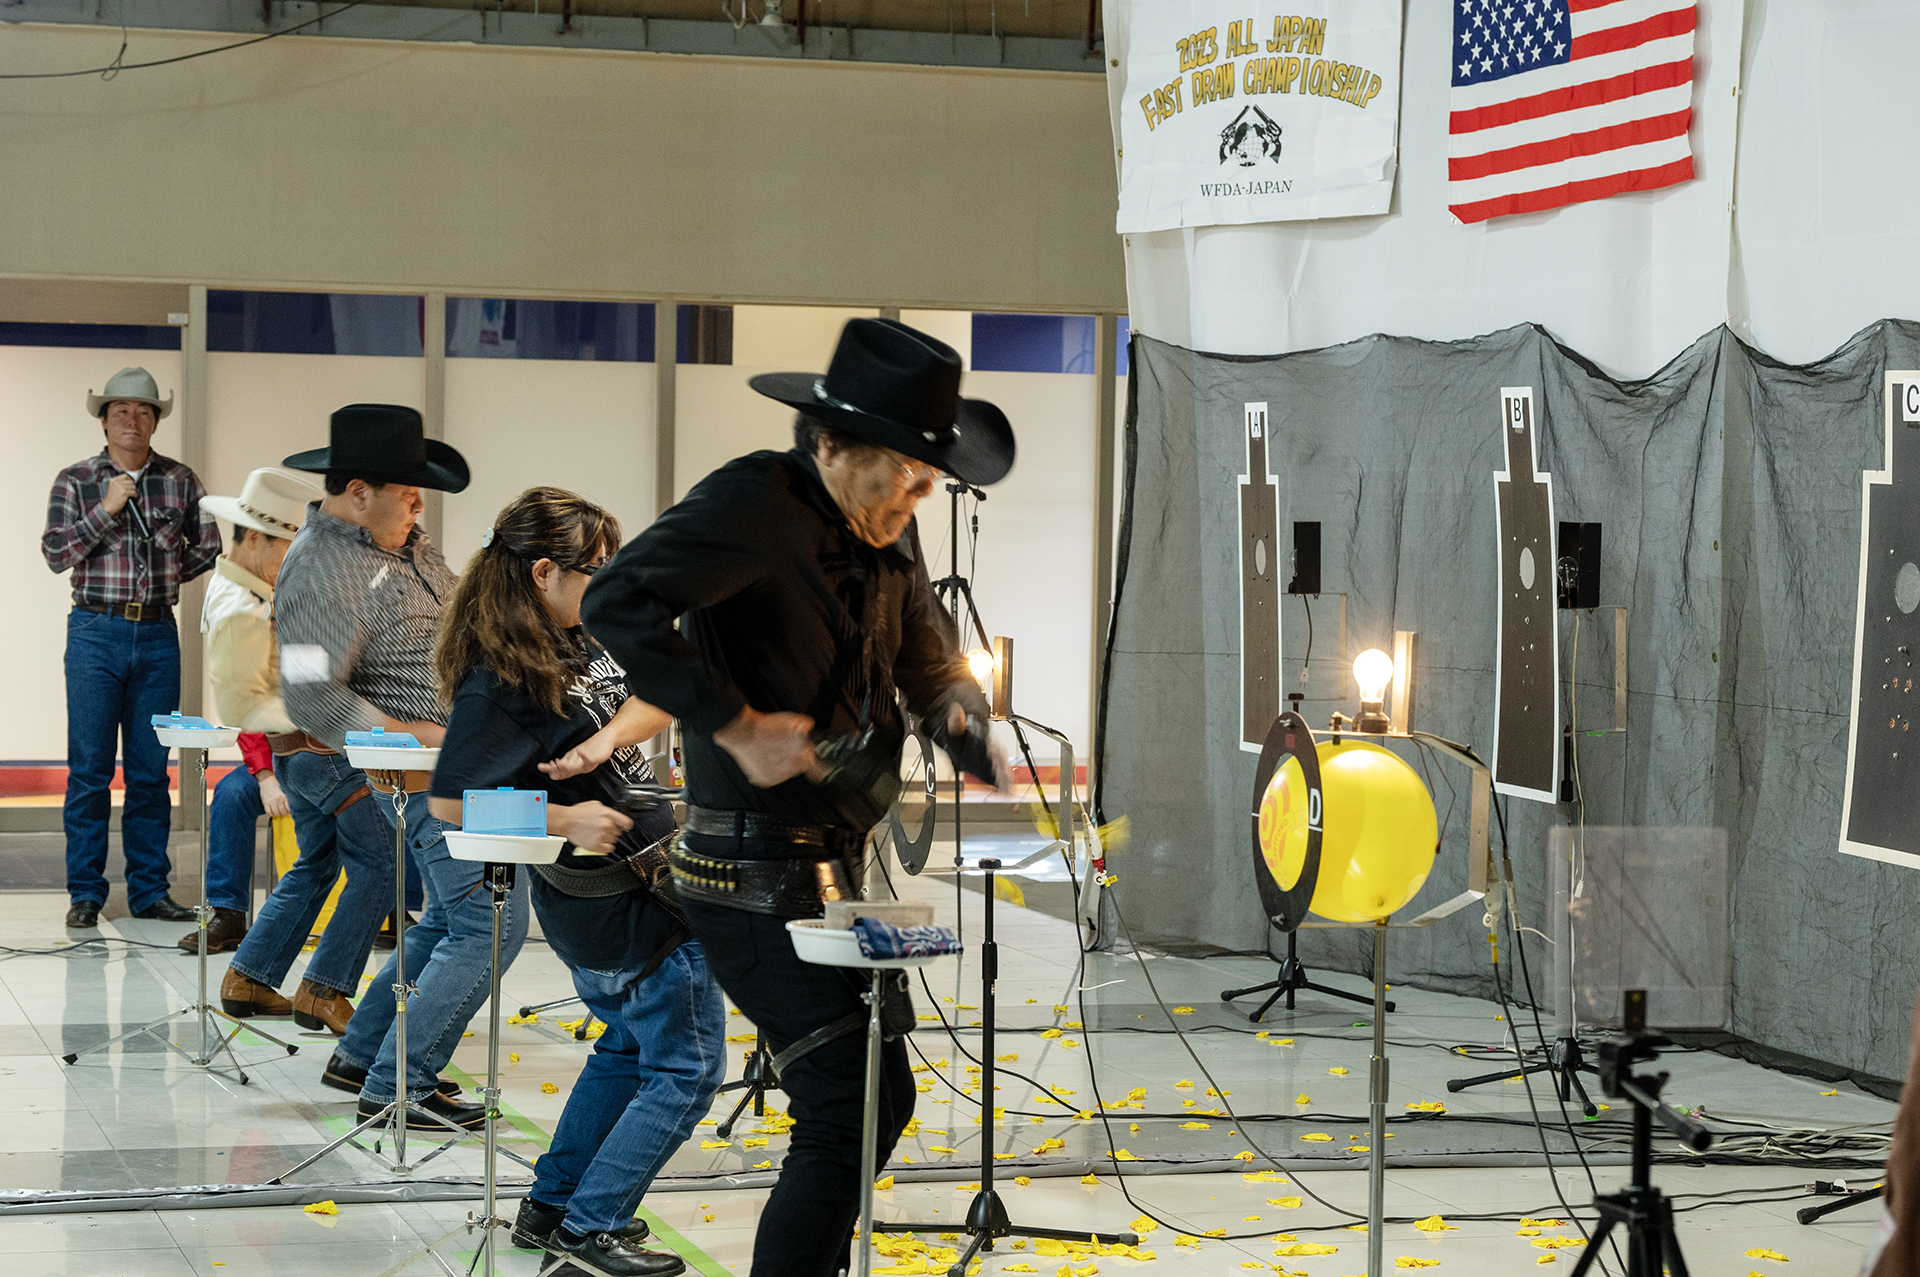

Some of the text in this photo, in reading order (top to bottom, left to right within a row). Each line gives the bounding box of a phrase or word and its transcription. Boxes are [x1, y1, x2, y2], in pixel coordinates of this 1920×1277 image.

[1176, 16, 1327, 73] 2023 ALL JAPAN
[1139, 57, 1382, 131] FAST DRAW CHAMPIONSHIP
[1514, 398, 1521, 421] B
[1907, 384, 1919, 414] C
[1253, 411, 1259, 432] A
[925, 762, 934, 793] C
[1309, 788, 1321, 825] D
